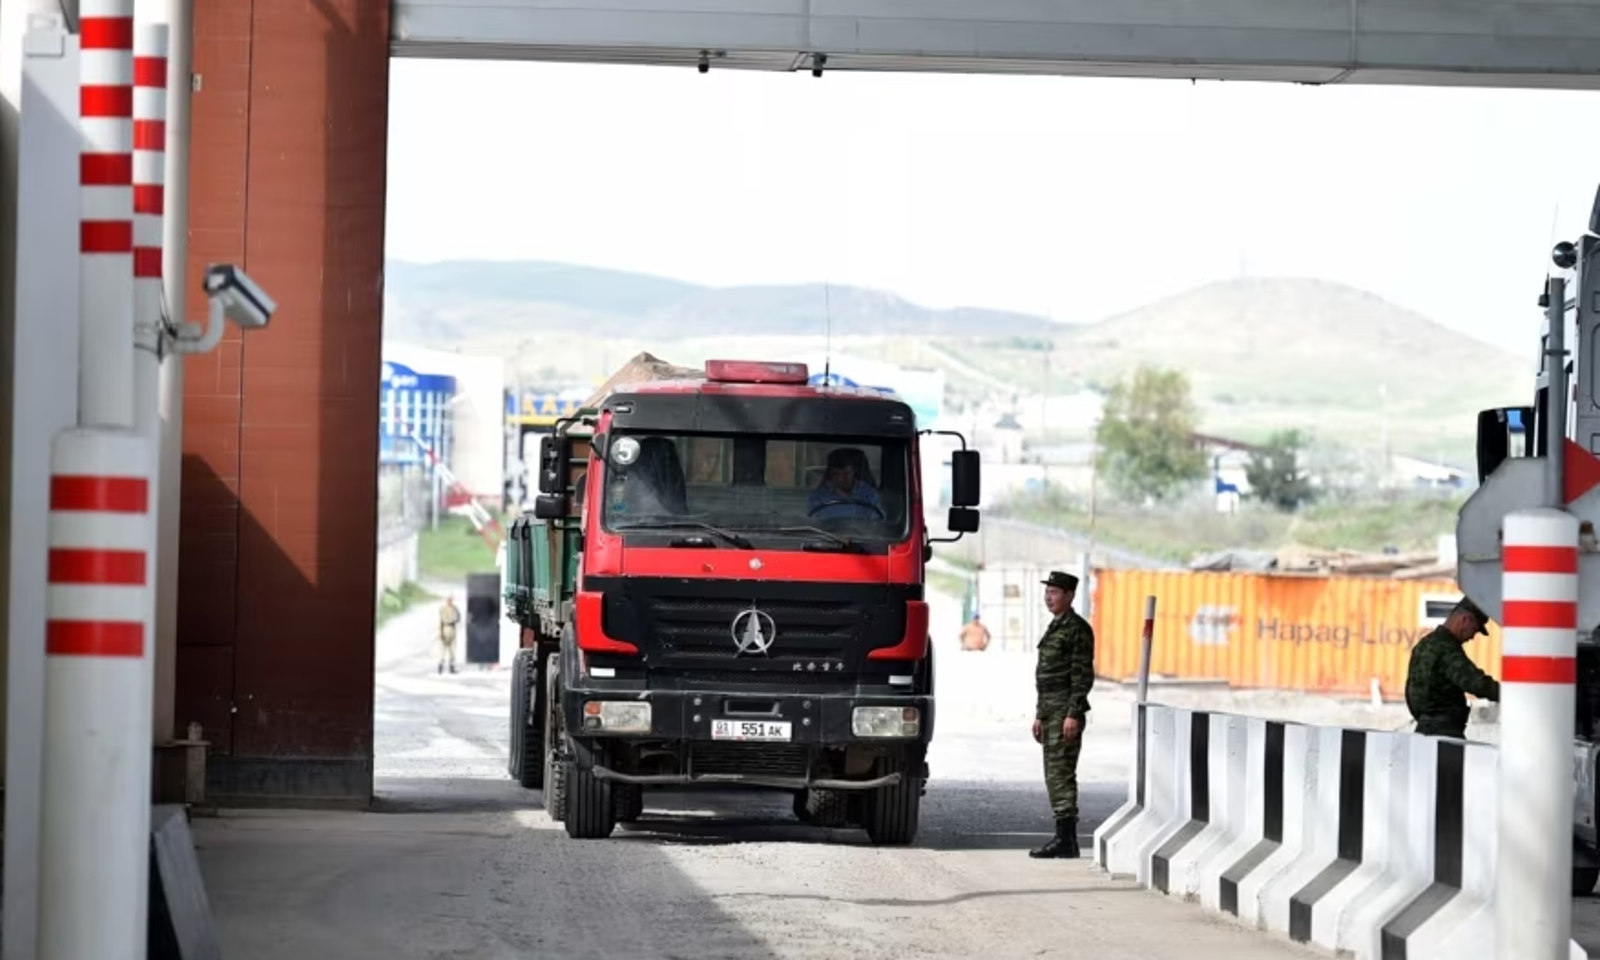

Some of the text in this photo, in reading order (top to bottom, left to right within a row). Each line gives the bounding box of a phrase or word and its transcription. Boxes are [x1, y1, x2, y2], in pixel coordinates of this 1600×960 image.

[617, 438, 633, 461] 5
[741, 722, 765, 736] 551
[768, 725, 783, 736] AK
